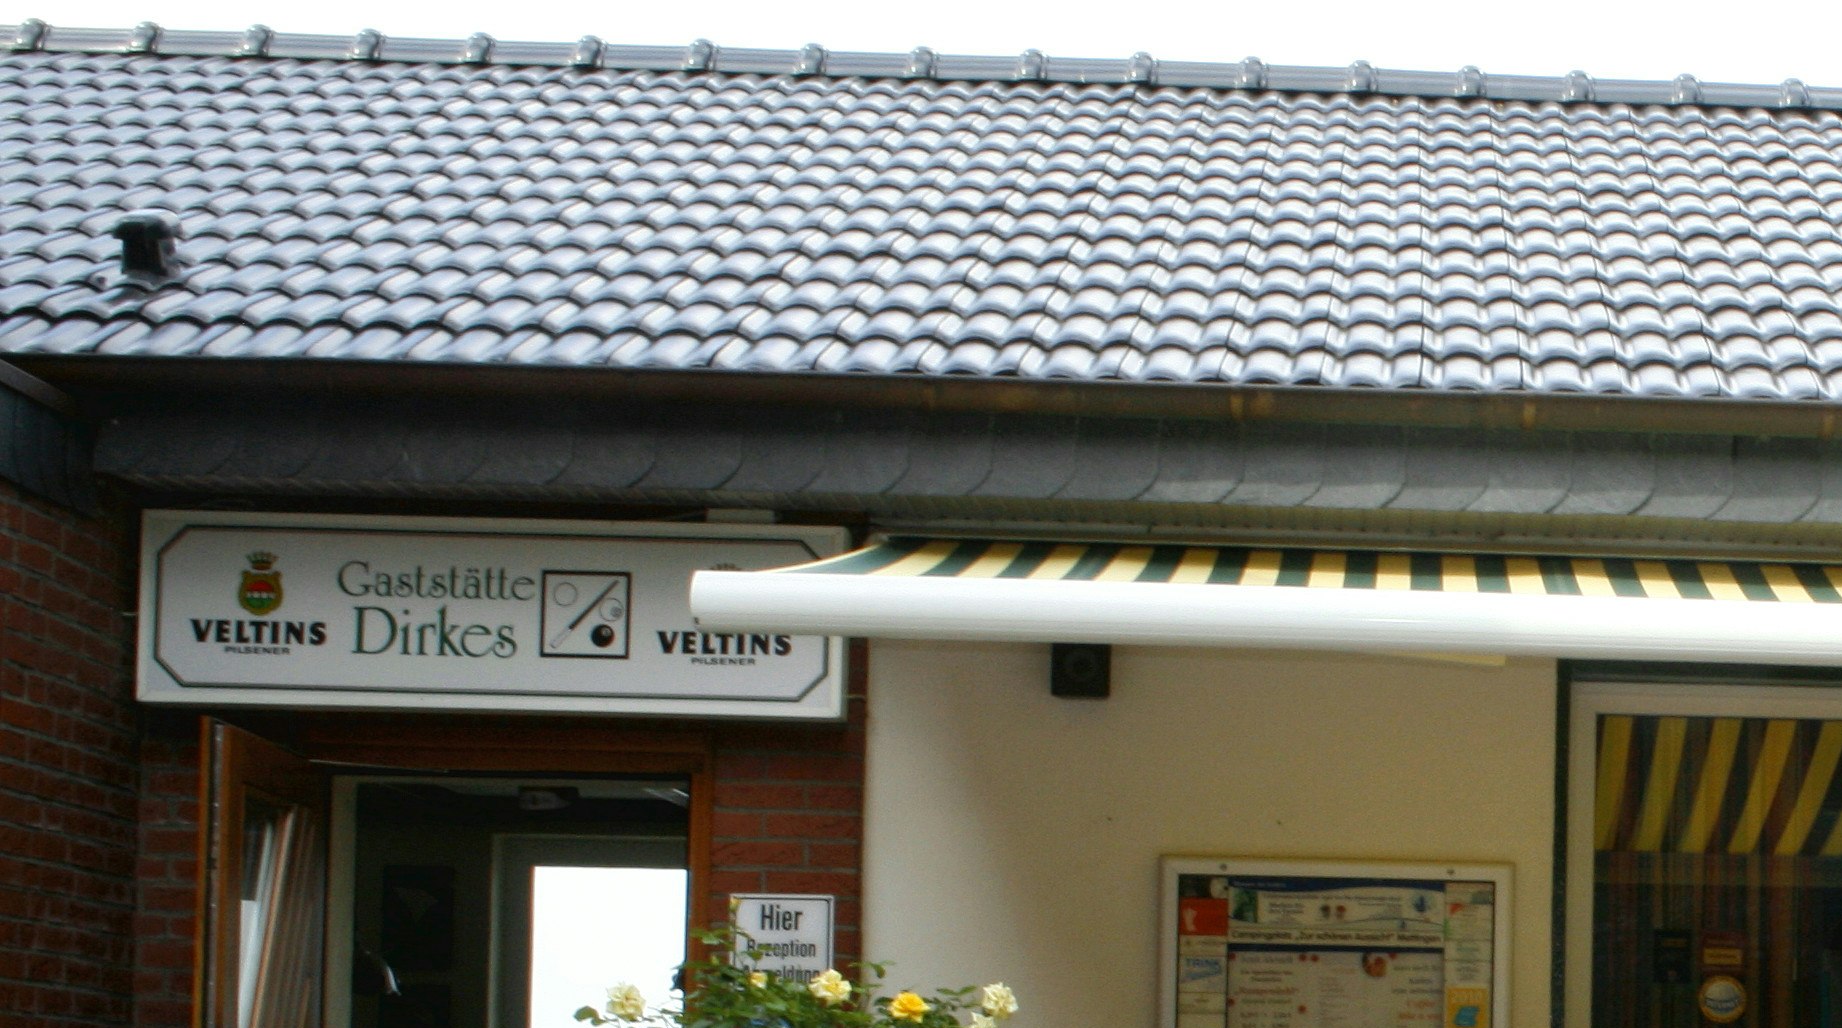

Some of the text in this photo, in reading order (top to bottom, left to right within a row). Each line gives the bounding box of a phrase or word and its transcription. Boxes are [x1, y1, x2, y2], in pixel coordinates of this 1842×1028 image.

[337, 561, 536, 600] Gaststätte
[190, 618, 328, 646] VELTINS
[352, 605, 518, 658] Dirkes
[656, 630, 793, 656] VELTINS
[224, 646, 291, 655] PILSENER
[690, 657, 756, 666] PILSENER
[760, 904, 803, 931] Hier
